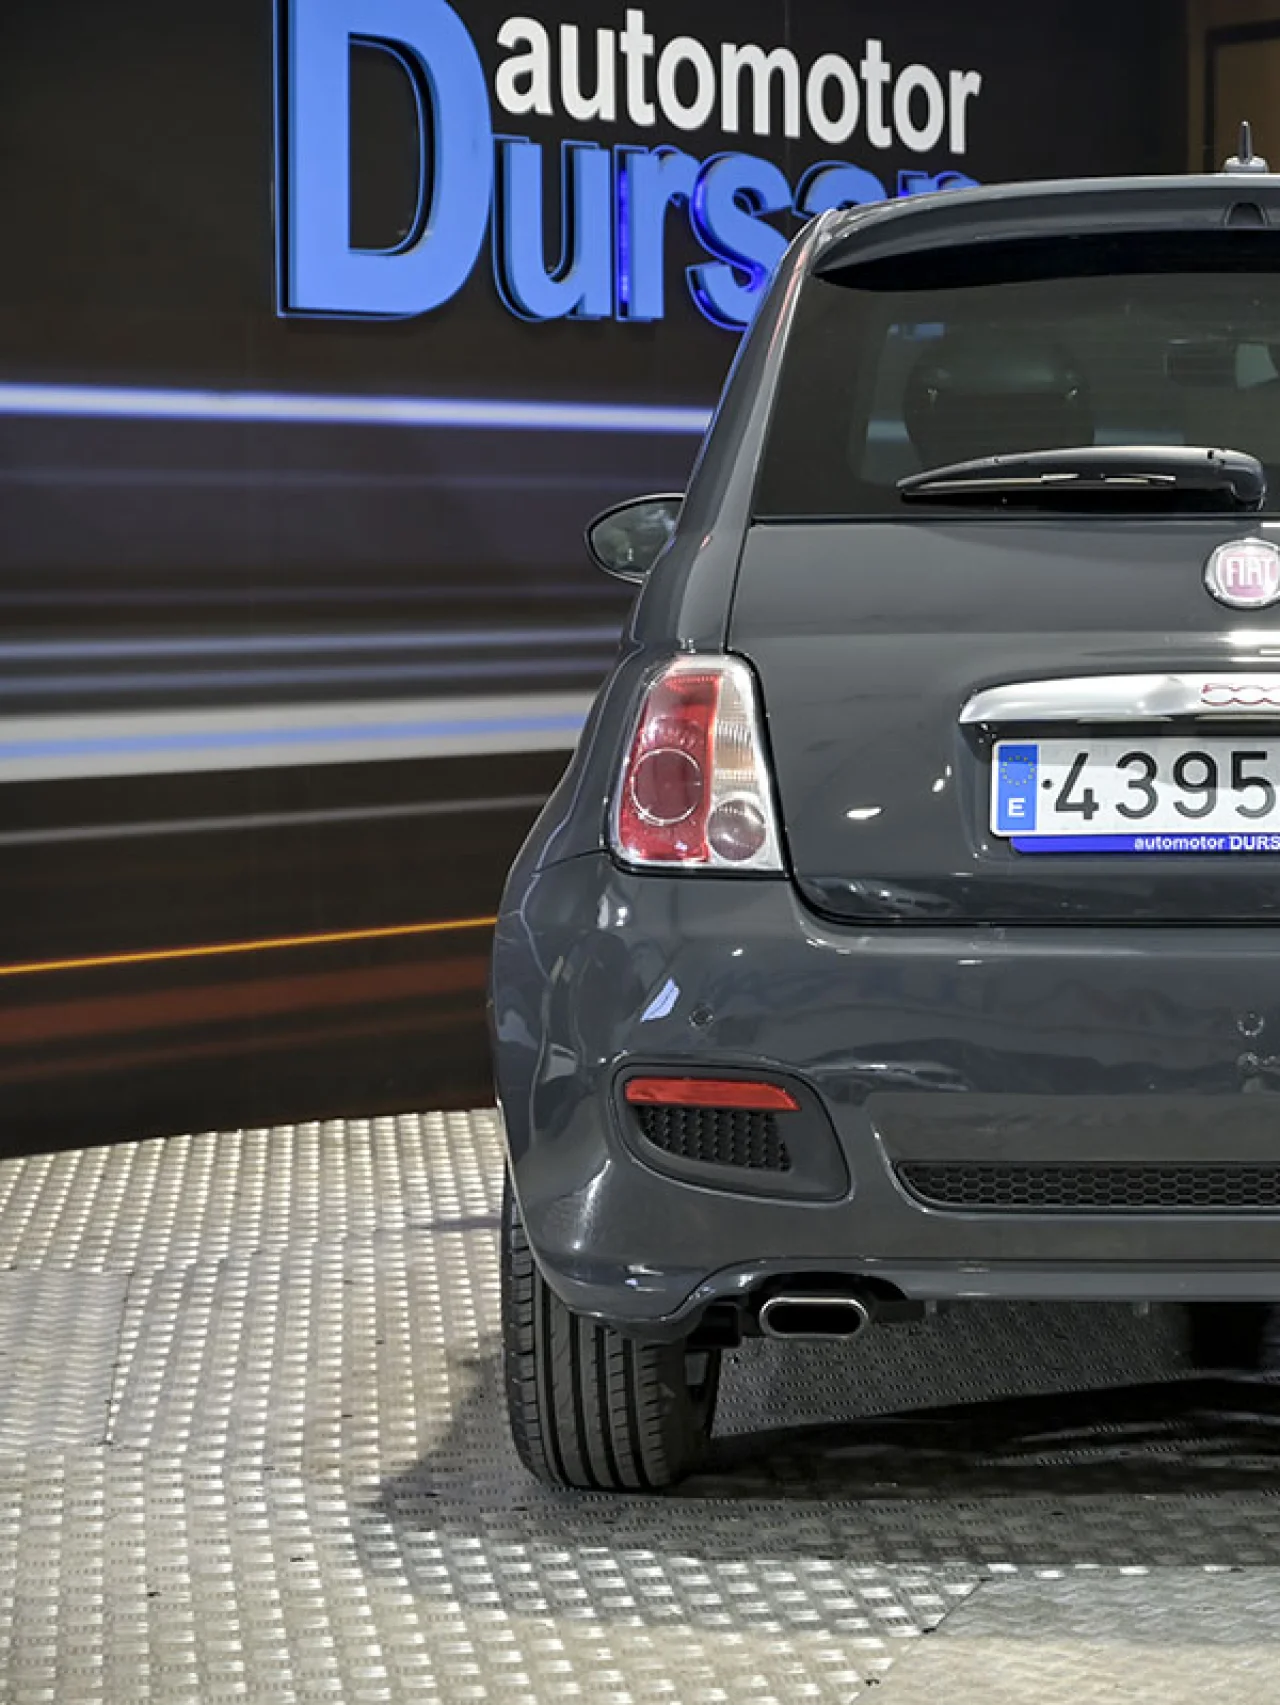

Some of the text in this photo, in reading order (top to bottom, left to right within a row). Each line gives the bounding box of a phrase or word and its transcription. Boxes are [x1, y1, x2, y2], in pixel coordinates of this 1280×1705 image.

[495, 9, 981, 154] automotor
[274, 0, 982, 332] Durs
[1226, 556, 1276, 586] FIAT
[1007, 797, 1025, 817] E
[1054, 750, 1276, 820] 4395
[1133, 835, 1224, 850] automotor
